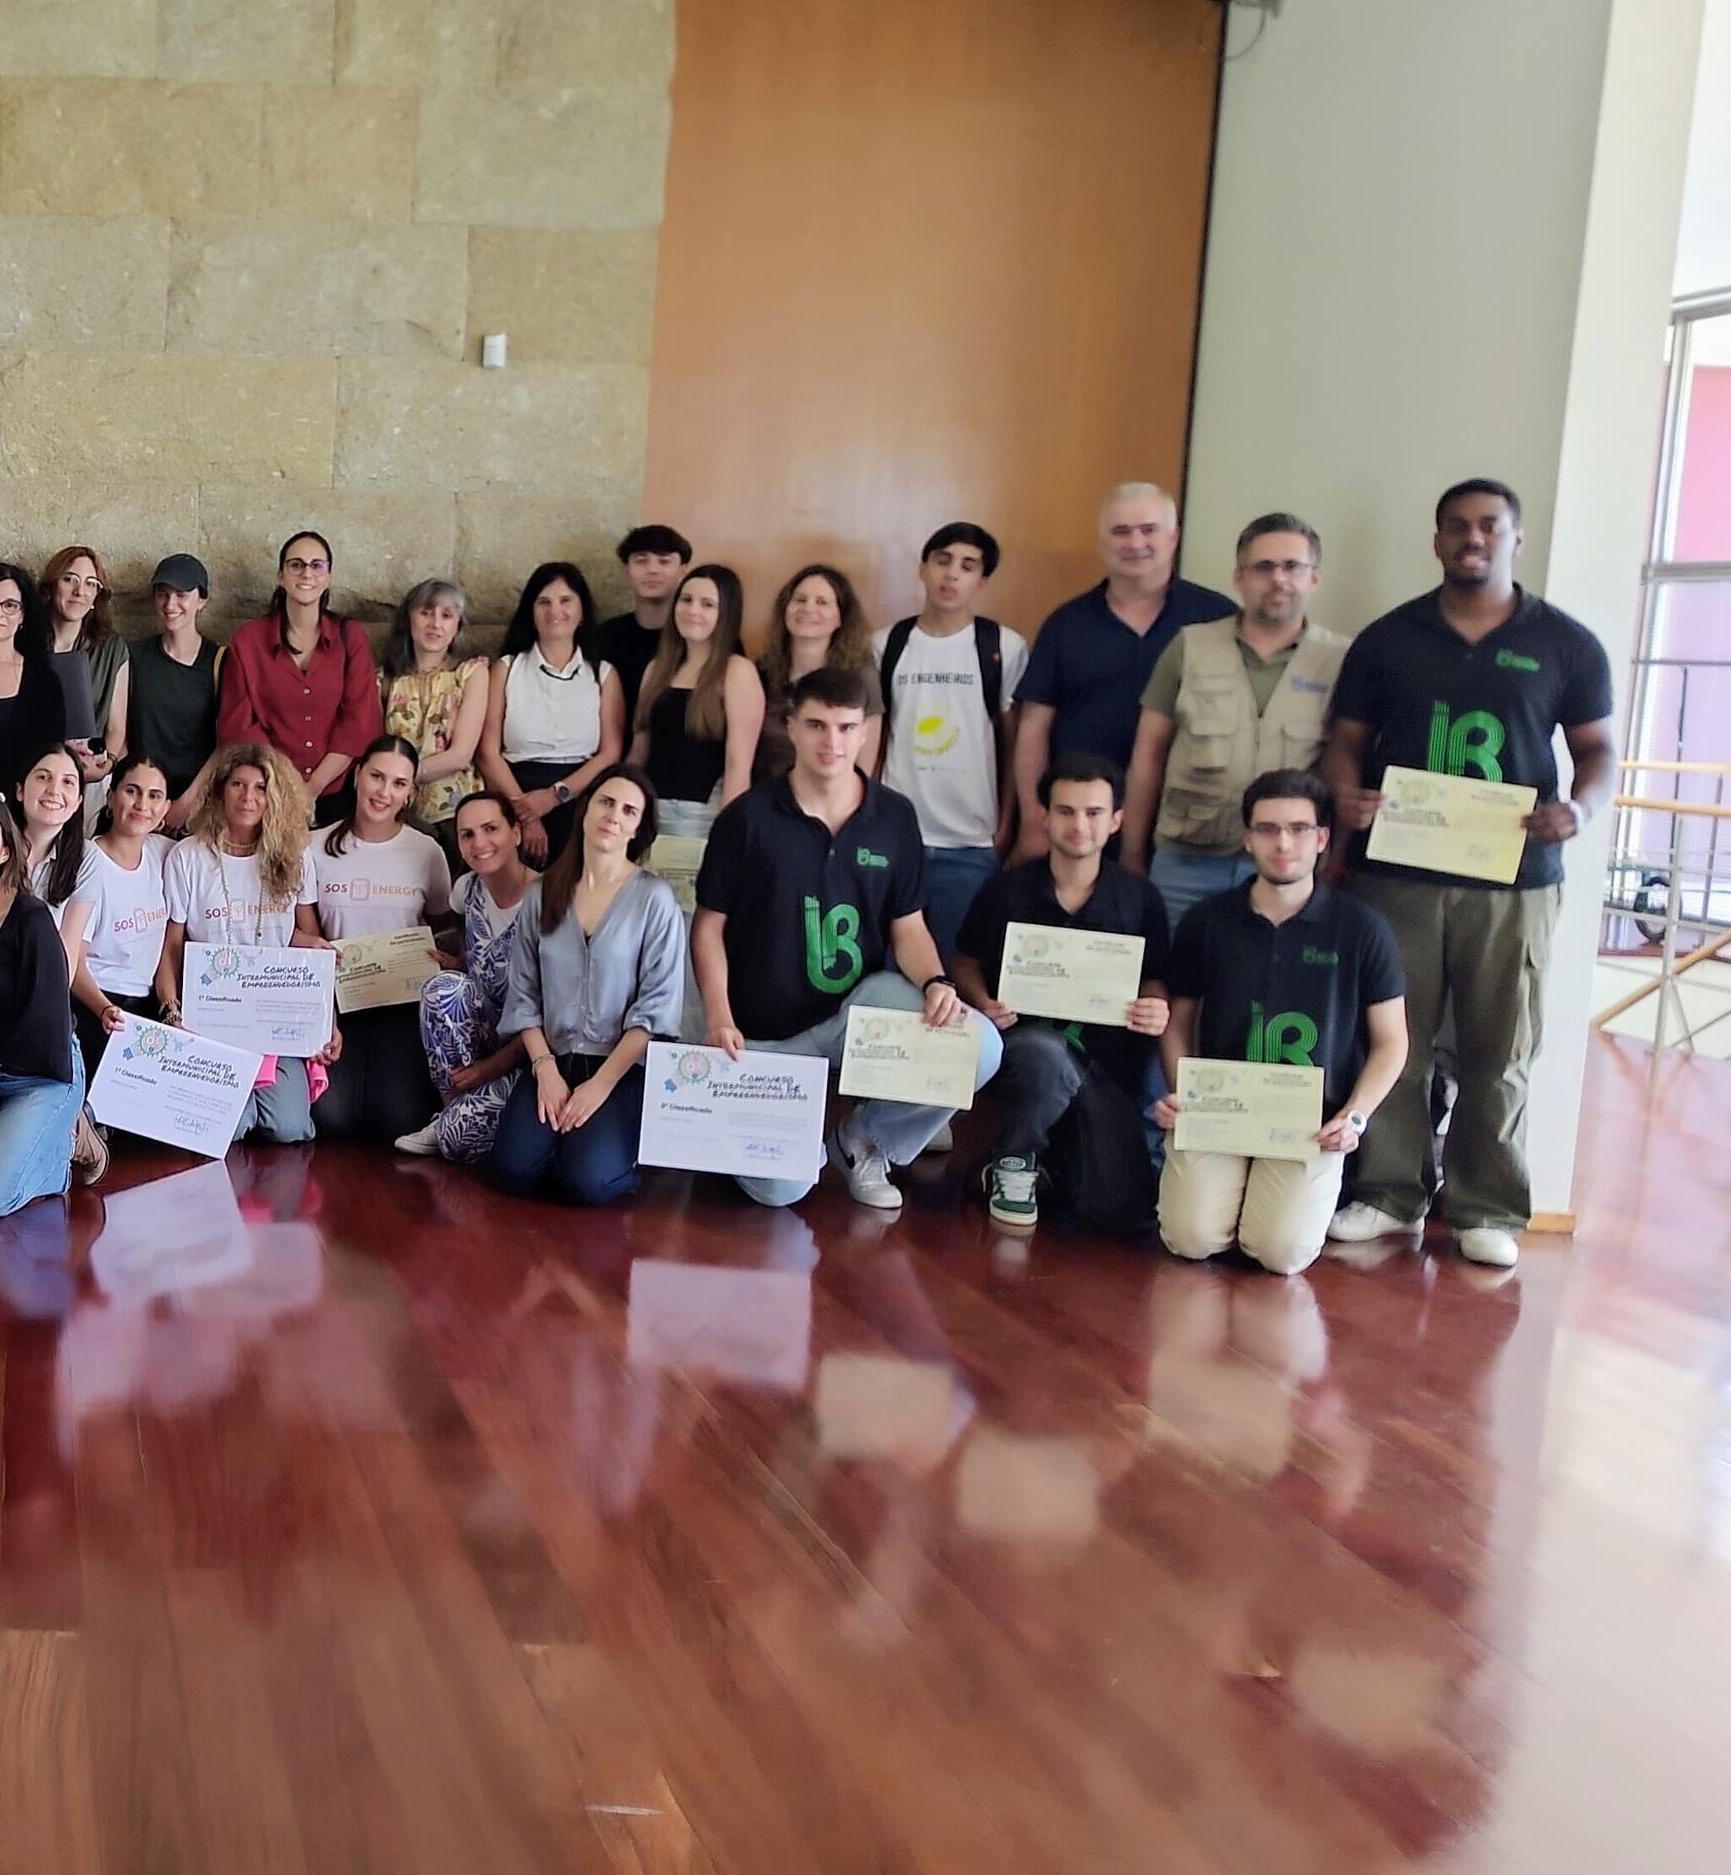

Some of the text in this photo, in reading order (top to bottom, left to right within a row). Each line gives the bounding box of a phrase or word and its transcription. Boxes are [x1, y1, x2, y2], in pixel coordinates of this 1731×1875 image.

[324, 883, 348, 893] SOS
[205, 907, 228, 919] SOS
[114, 918, 134, 932] SOS
[263, 966, 309, 974] CONCURSO
[237, 973, 299, 981] INTERMUNICIPAL
[158, 1056, 222, 1078] INTERMUNICIPAL
[187, 1054, 233, 1072] CONCURSO
[739, 1073, 795, 1084] CONCURSO
